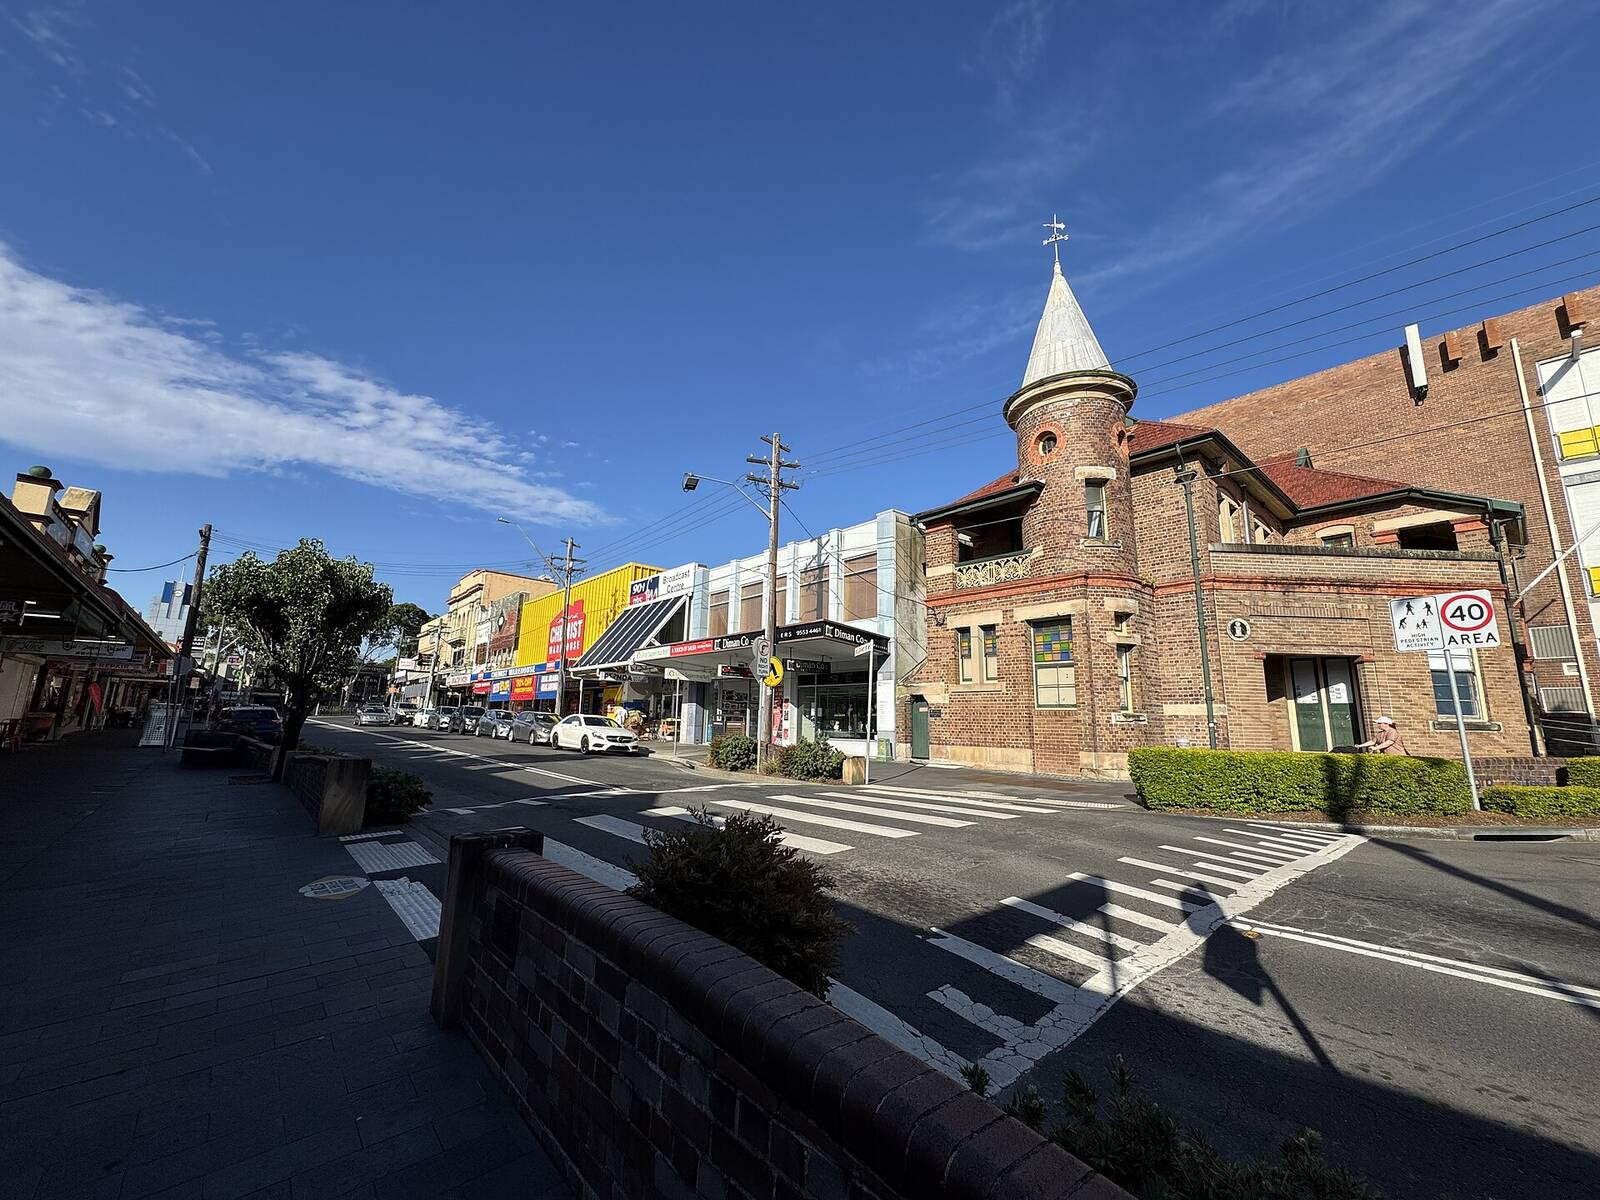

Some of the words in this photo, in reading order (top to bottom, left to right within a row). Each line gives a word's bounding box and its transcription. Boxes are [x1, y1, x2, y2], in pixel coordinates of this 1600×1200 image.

[663, 569, 690, 584] Broadcast
[666, 582, 685, 594] Centre
[1450, 603, 1485, 621] 40
[550, 620, 583, 643] CHEIST
[834, 628, 855, 642] Diman
[722, 637, 740, 649] Diman
[1448, 632, 1498, 646] AREA
[549, 641, 581, 655] WAROUSE
